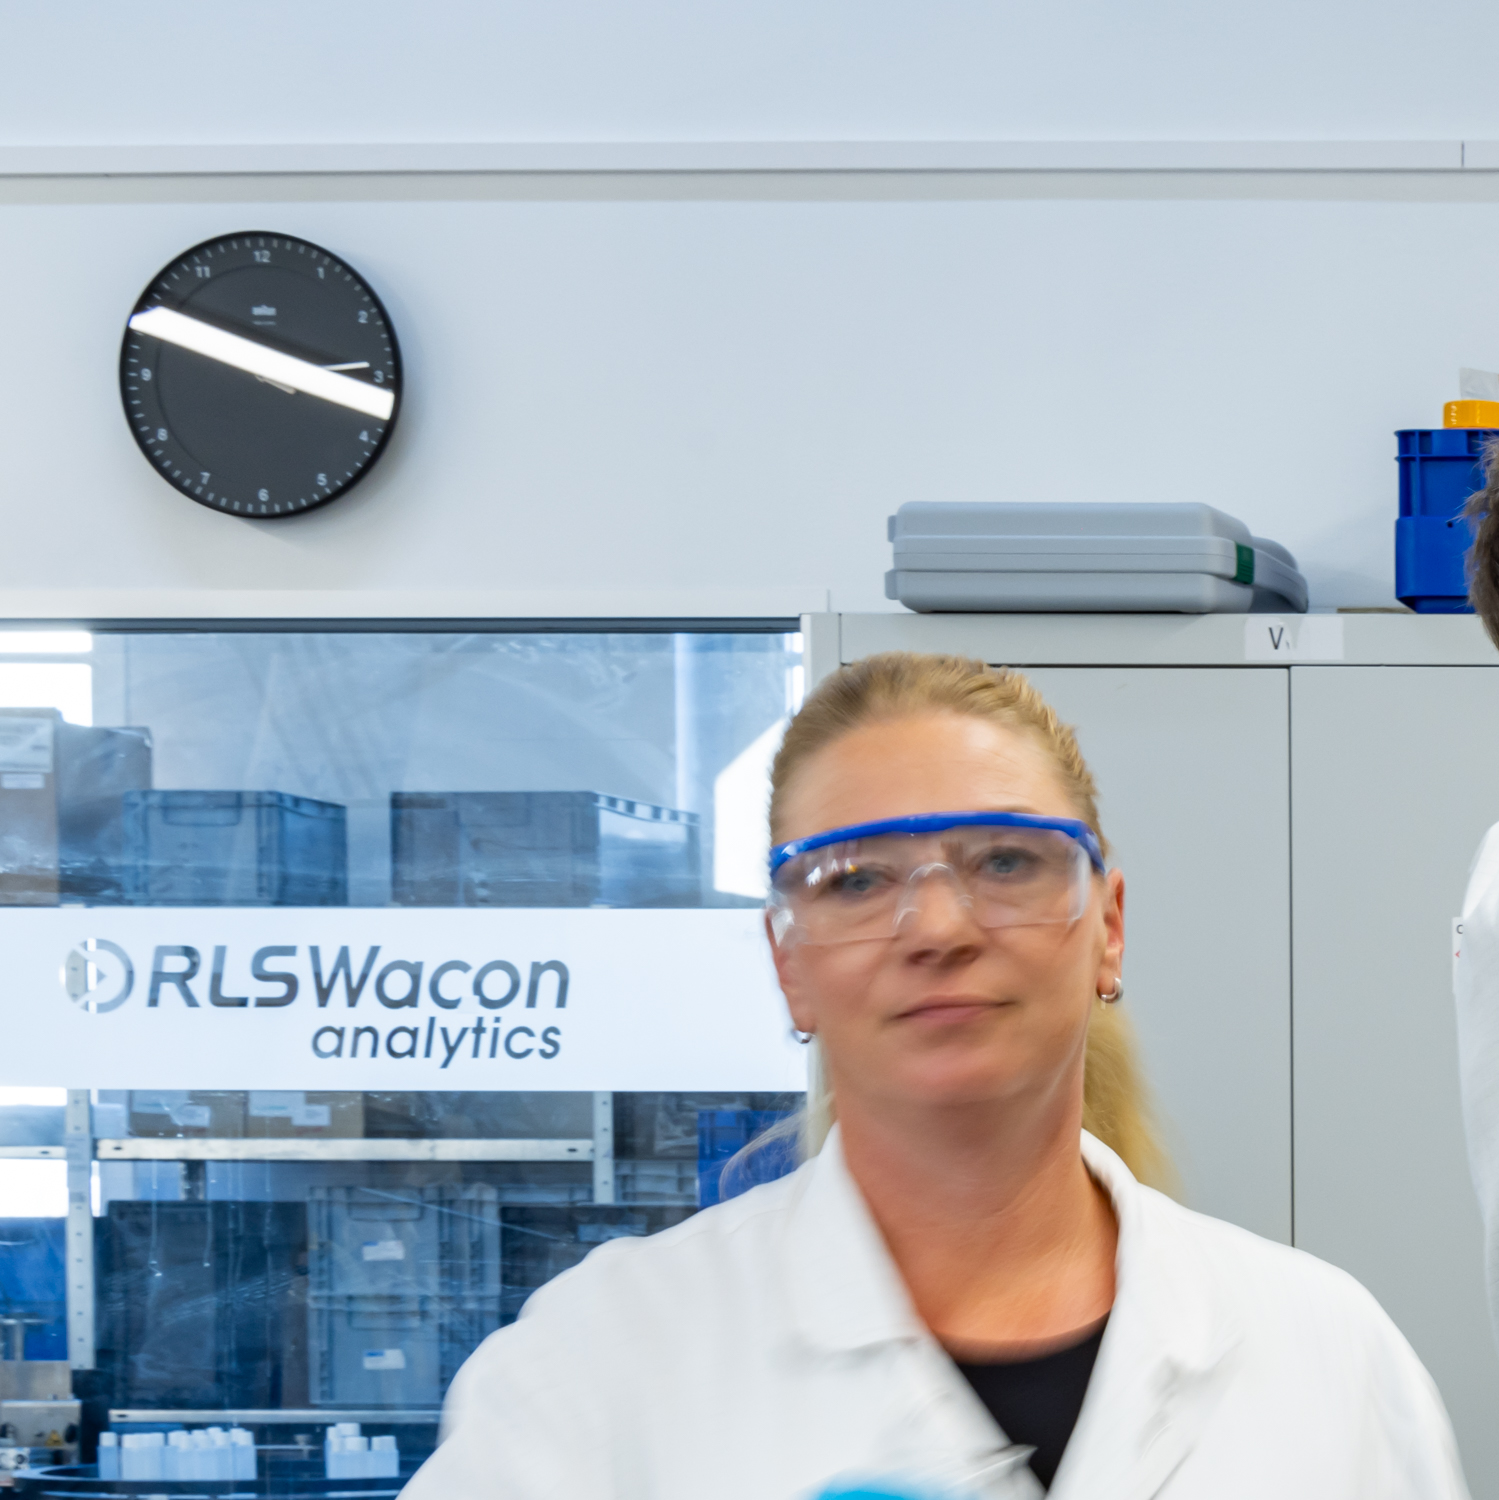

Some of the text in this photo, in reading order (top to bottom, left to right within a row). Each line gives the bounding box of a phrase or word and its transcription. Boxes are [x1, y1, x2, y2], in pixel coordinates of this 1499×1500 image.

[253, 250, 271, 263] 12
[196, 266, 211, 278] 11
[316, 267, 325, 280] 1
[357, 311, 369, 324] 2
[141, 368, 152, 381] 9
[374, 370, 384, 383] 3
[157, 428, 168, 441] 8
[358, 430, 370, 442] 4
[200, 472, 210, 484] 7
[317, 473, 327, 486] 5
[258, 488, 269, 500] 6
[311, 1015, 562, 1069] analytics
